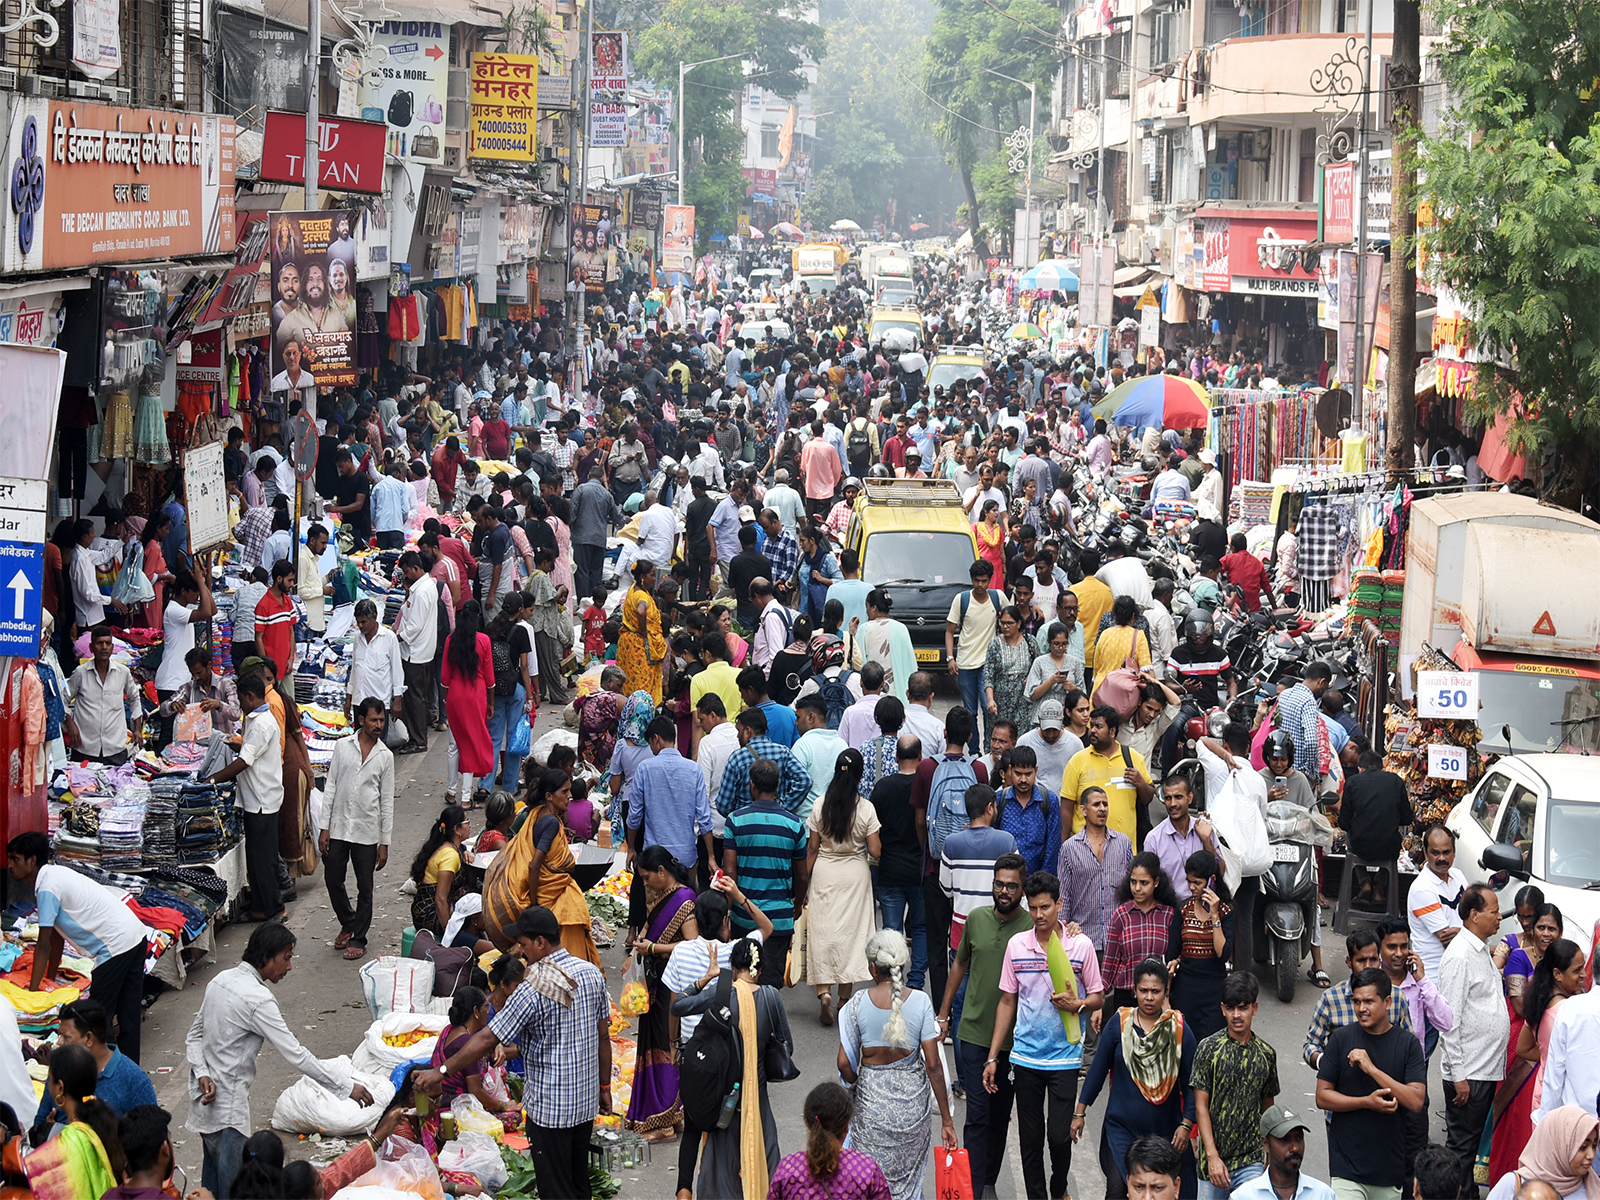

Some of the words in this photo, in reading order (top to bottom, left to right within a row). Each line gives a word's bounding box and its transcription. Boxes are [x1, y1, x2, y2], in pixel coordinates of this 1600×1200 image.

[257, 30, 295, 40] SUVIDHA
[369, 21, 442, 38] UVIDHA
[473, 55, 534, 79] हॉटेल
[395, 71, 402, 79] &
[471, 79, 534, 101] मनहर
[608, 79, 627, 89] बाबा
[506, 100, 534, 119] फ्लोर
[591, 103, 604, 114] SAI
[605, 103, 626, 114] BABA
[477, 120, 527, 135] 7400005333
[53, 109, 66, 165] दि
[476, 137, 527, 151] 7400005444
[285, 154, 360, 184] TIAN
[113, 184, 131, 203] दादर
[132, 184, 151, 203] शाखा
[61, 213, 75, 233] THE
[77, 211, 103, 233] DECCAN
[105, 210, 142, 231] MERCHANTS
[163, 209, 178, 228] BANK
[299, 218, 332, 230] नवरात्र
[302, 230, 330, 243] उत्सव
[1248, 279, 1268, 290] MULTI
[1269, 280, 1305, 293] BRANDS
[191, 371, 220, 380] CENTRE
[1515, 662, 1543, 672] GOODS
[1545, 666, 1577, 676] CARRIER
